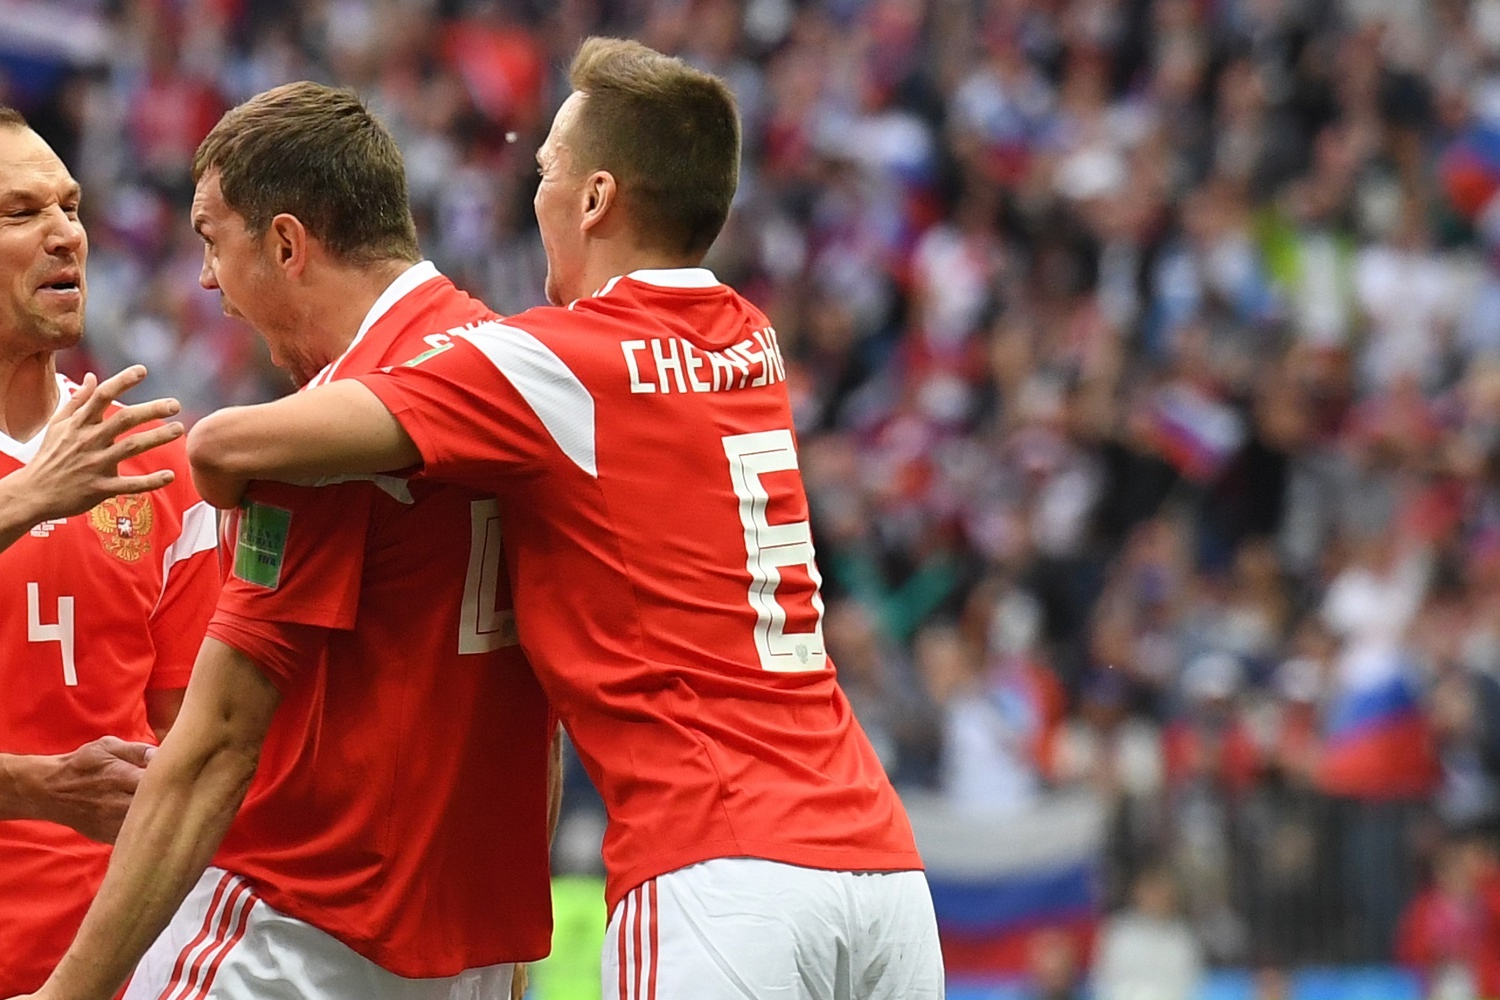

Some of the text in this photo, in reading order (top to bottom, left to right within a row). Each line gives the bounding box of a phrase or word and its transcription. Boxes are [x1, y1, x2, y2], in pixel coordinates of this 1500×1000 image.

[620, 326, 786, 394] CHERYSH
[721, 428, 827, 672] 6
[26, 581, 78, 687] 4
